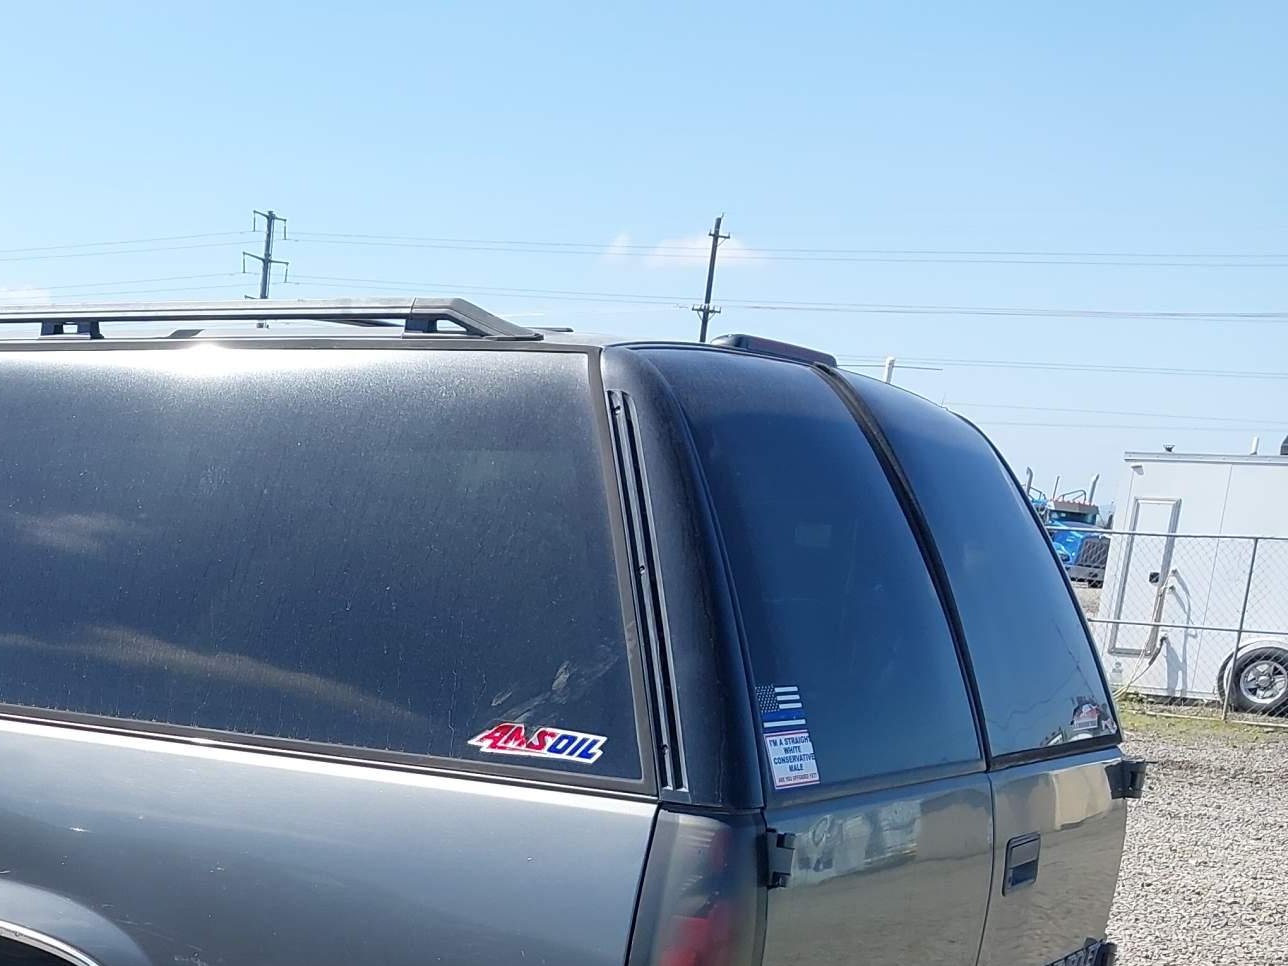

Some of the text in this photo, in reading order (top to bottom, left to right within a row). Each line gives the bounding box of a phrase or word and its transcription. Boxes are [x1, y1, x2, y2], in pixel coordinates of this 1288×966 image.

[475, 722, 600, 760] AMSOIL
[783, 745, 801, 754] WHITE
[774, 753, 816, 764] CONSERVATIVE
